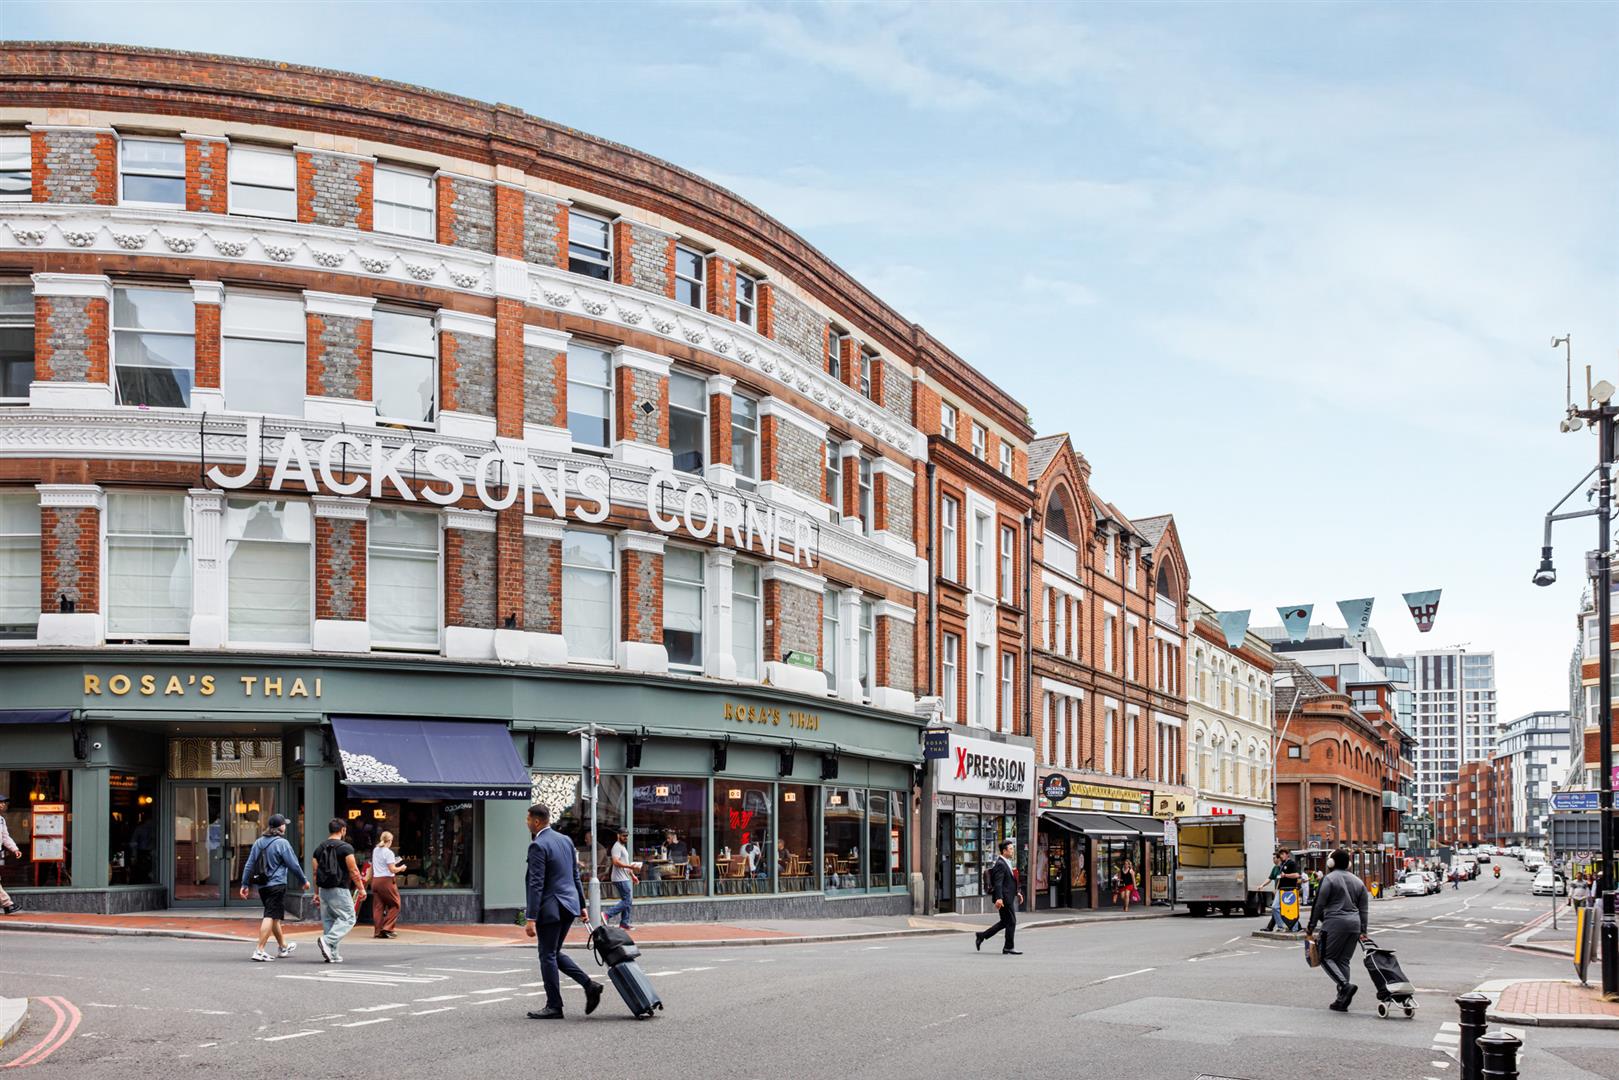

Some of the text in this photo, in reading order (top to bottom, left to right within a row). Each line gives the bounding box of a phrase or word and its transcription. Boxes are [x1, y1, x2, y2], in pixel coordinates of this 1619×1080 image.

[206, 419, 813, 568] JACKSONS CORNER
[83, 674, 322, 698] ROSA'S THAI
[724, 702, 819, 731] ROSA'S THAI
[955, 746, 1026, 782] XPRESSION
[1006, 782, 1025, 792] BEAUTY
